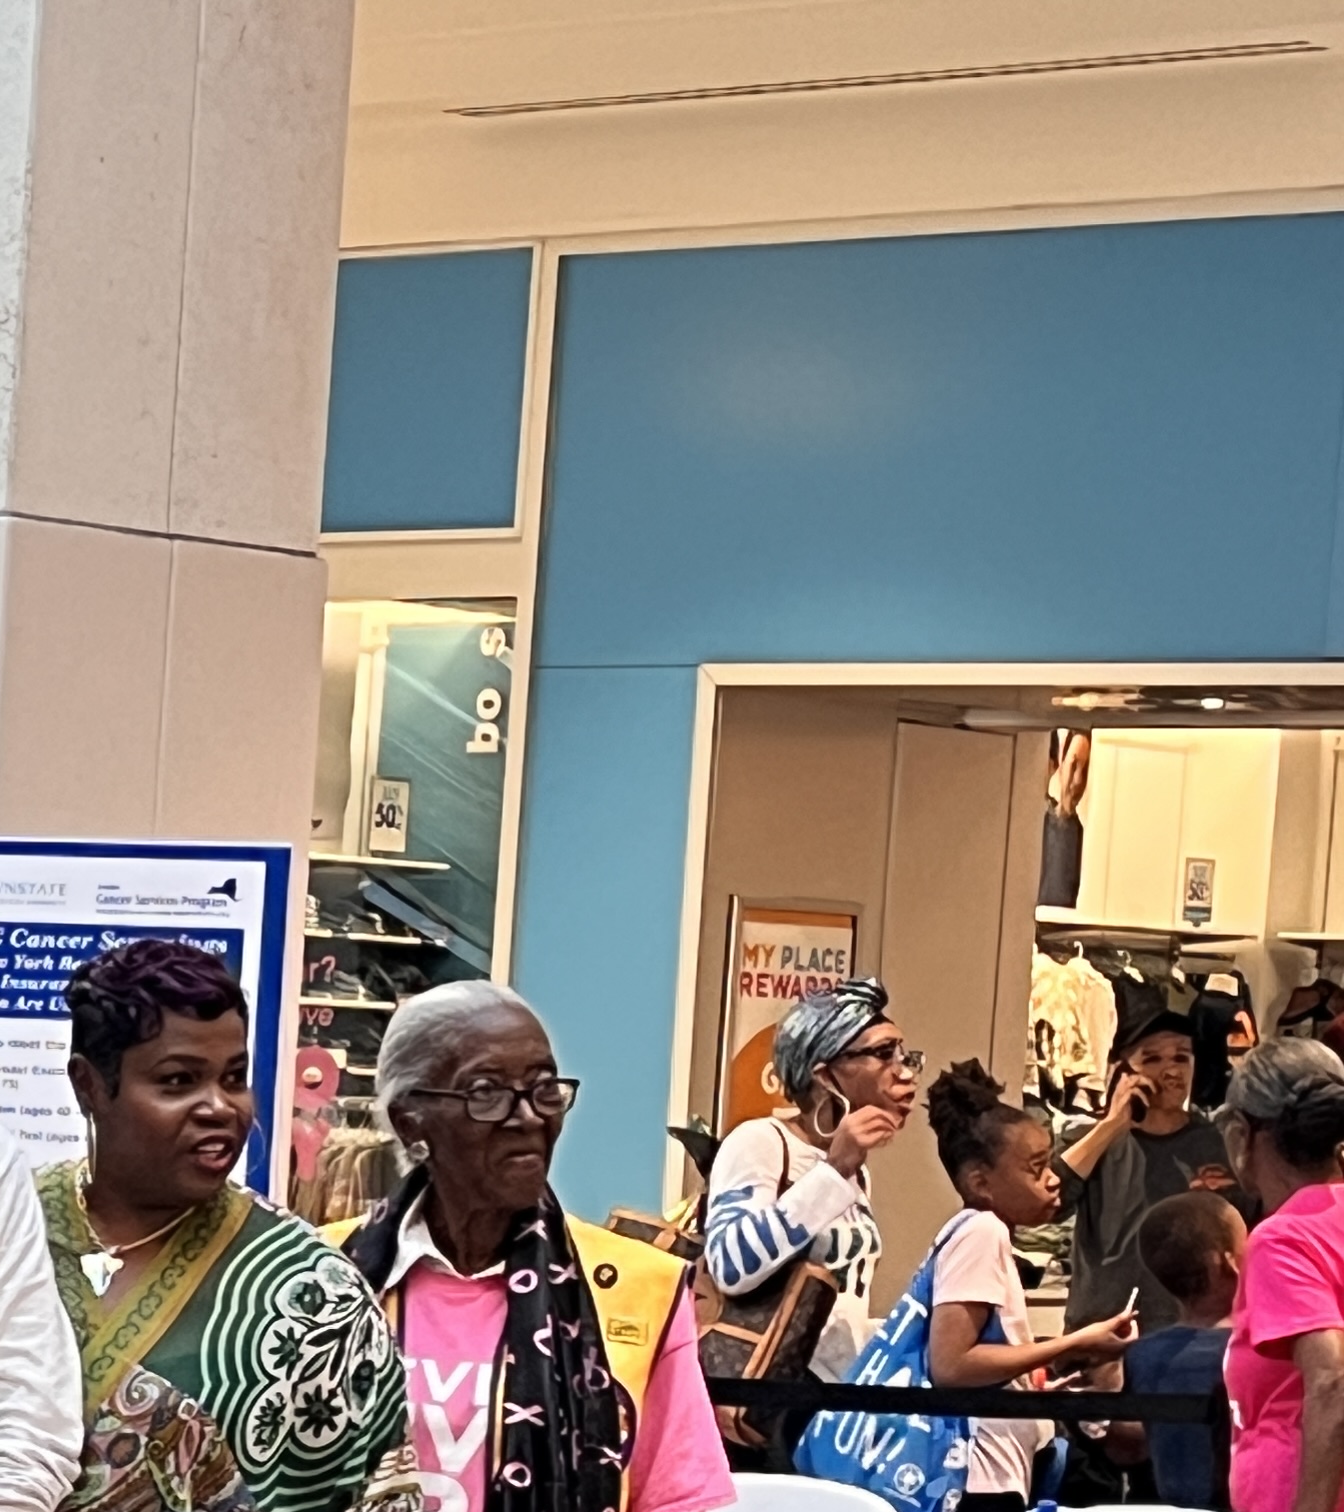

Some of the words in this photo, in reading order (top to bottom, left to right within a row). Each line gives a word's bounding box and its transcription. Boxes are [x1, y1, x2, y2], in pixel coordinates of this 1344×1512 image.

[96, 894, 132, 905] Cancer
[9, 928, 94, 949] Cancer
[14, 954, 55, 970] York
[742, 943, 776, 968] MY
[780, 945, 847, 974] PLACE
[13, 996, 44, 1011] Are
